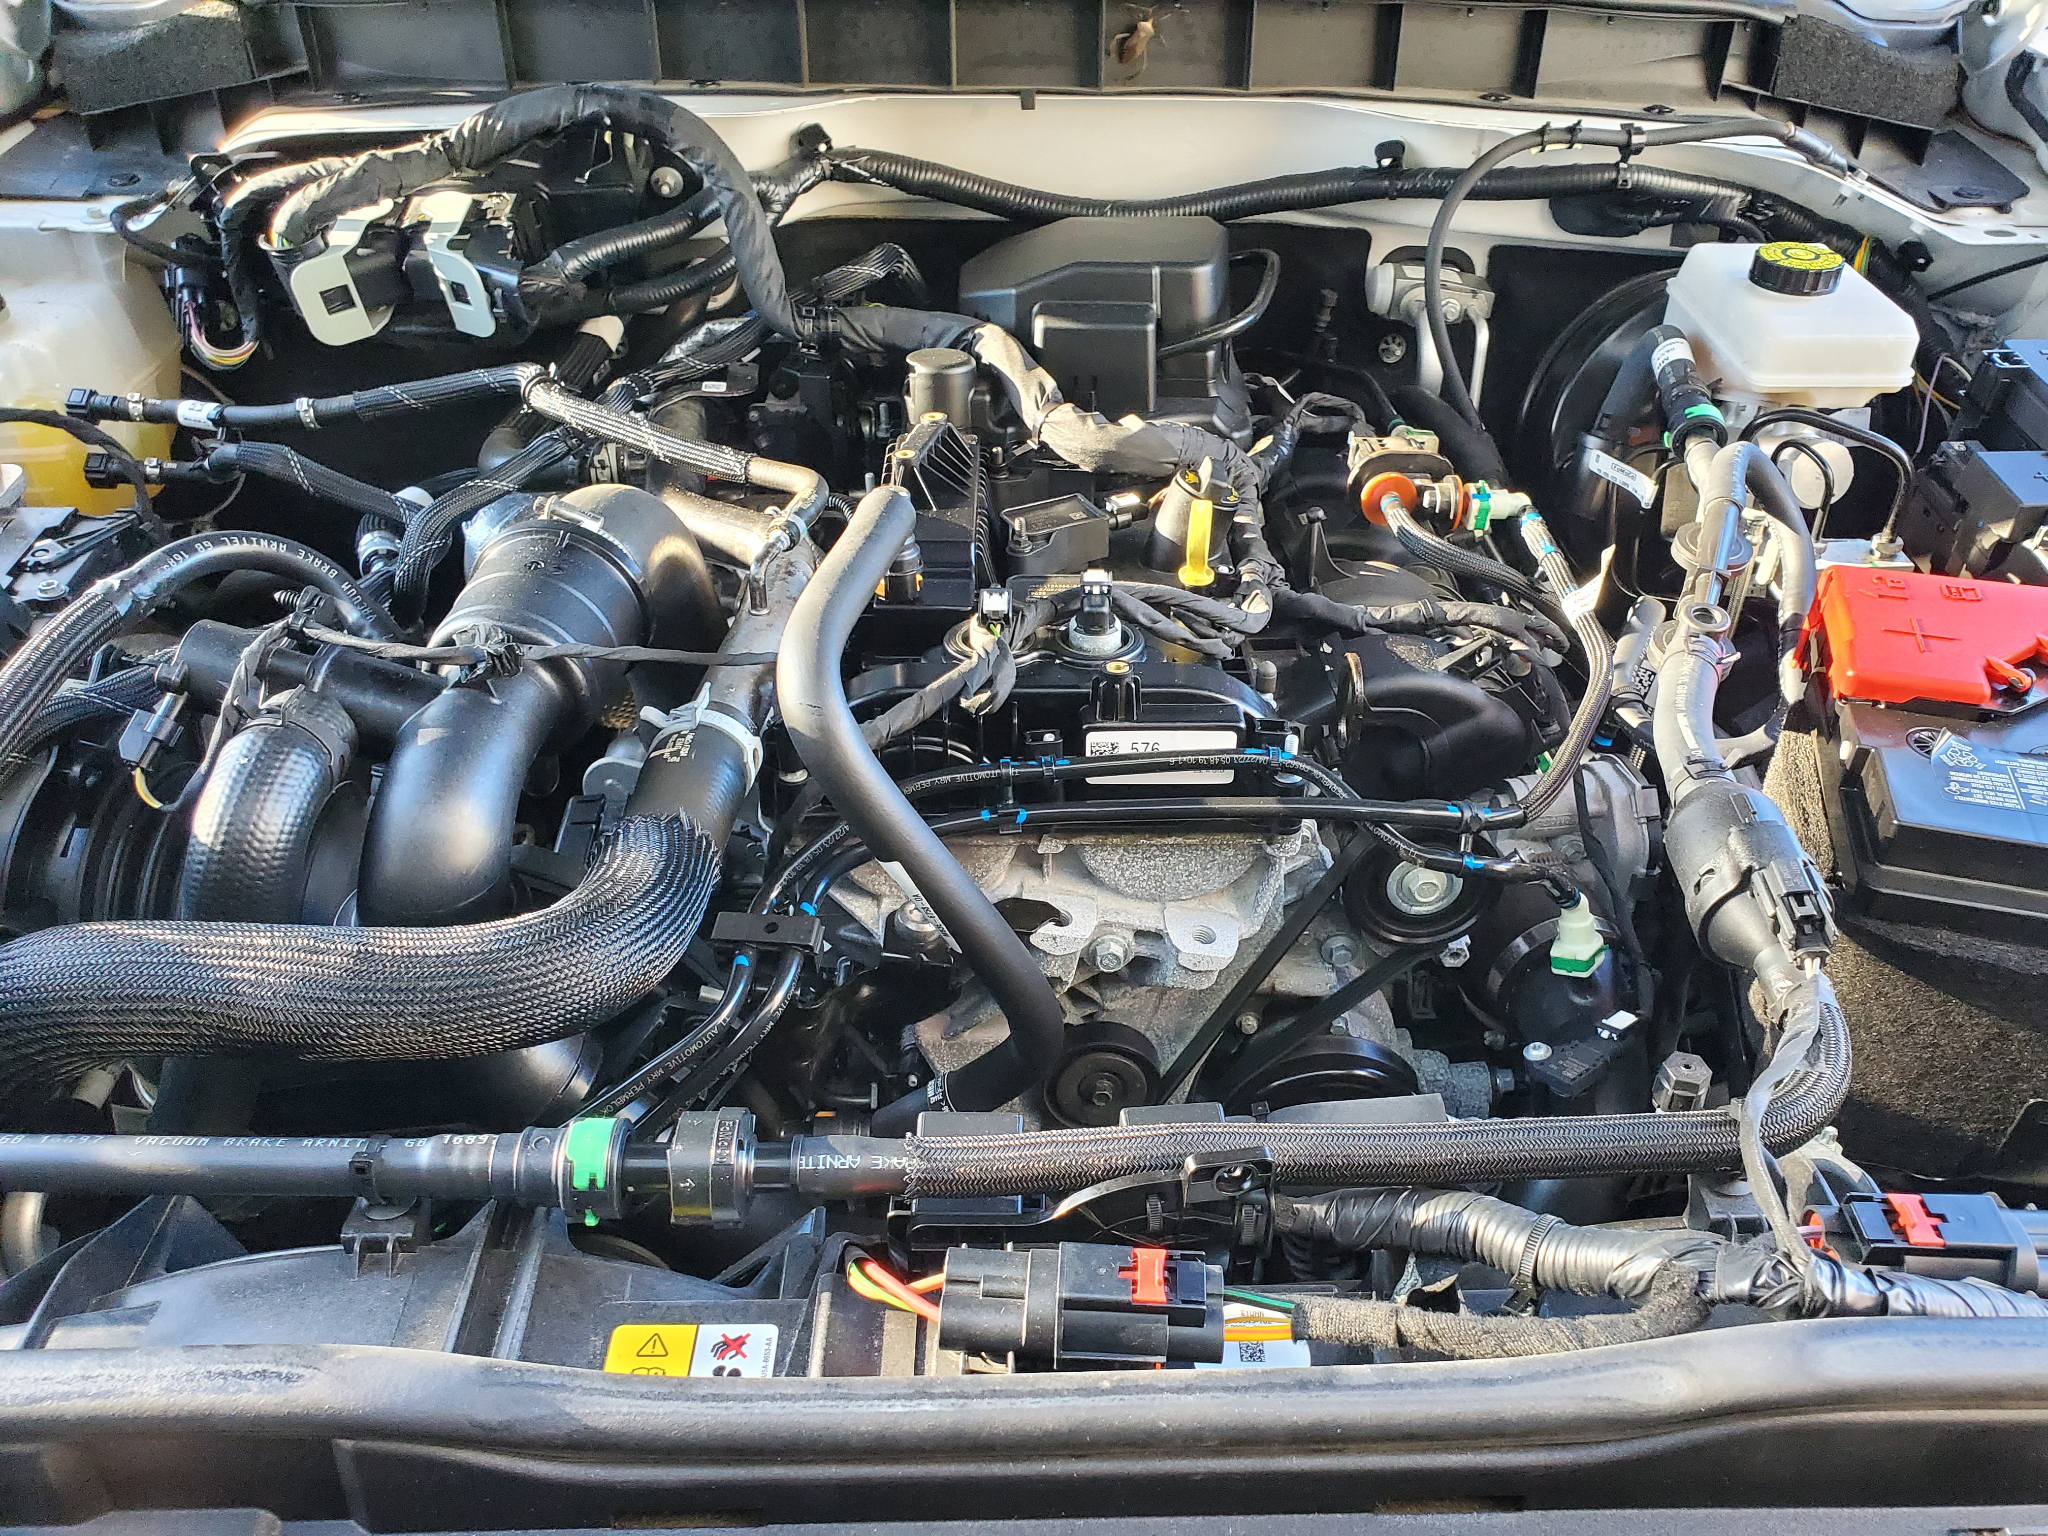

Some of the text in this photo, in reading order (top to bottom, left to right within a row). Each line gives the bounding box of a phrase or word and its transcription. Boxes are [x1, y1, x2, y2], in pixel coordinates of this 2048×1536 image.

[195, 541, 213, 553] GB
[221, 537, 287, 553] ARNITEL
[296, 548, 338, 578] BRAKE
[340, 582, 377, 623] VACUUM
[1131, 742, 1160, 753] 576
[934, 776, 951, 786] MRY
[956, 768, 1004, 783] UTOMOTIVE
[665, 1025, 719, 1069] AUTOMOTIVE
[646, 1068, 665, 1084] MRY
[134, 1136, 212, 1147] VACUUM
[223, 1137, 289, 1148] BRAKE
[301, 1138, 388, 1149] ARNIT
[404, 1138, 430, 1148] GB
[799, 1154, 861, 1169] ARNITE
